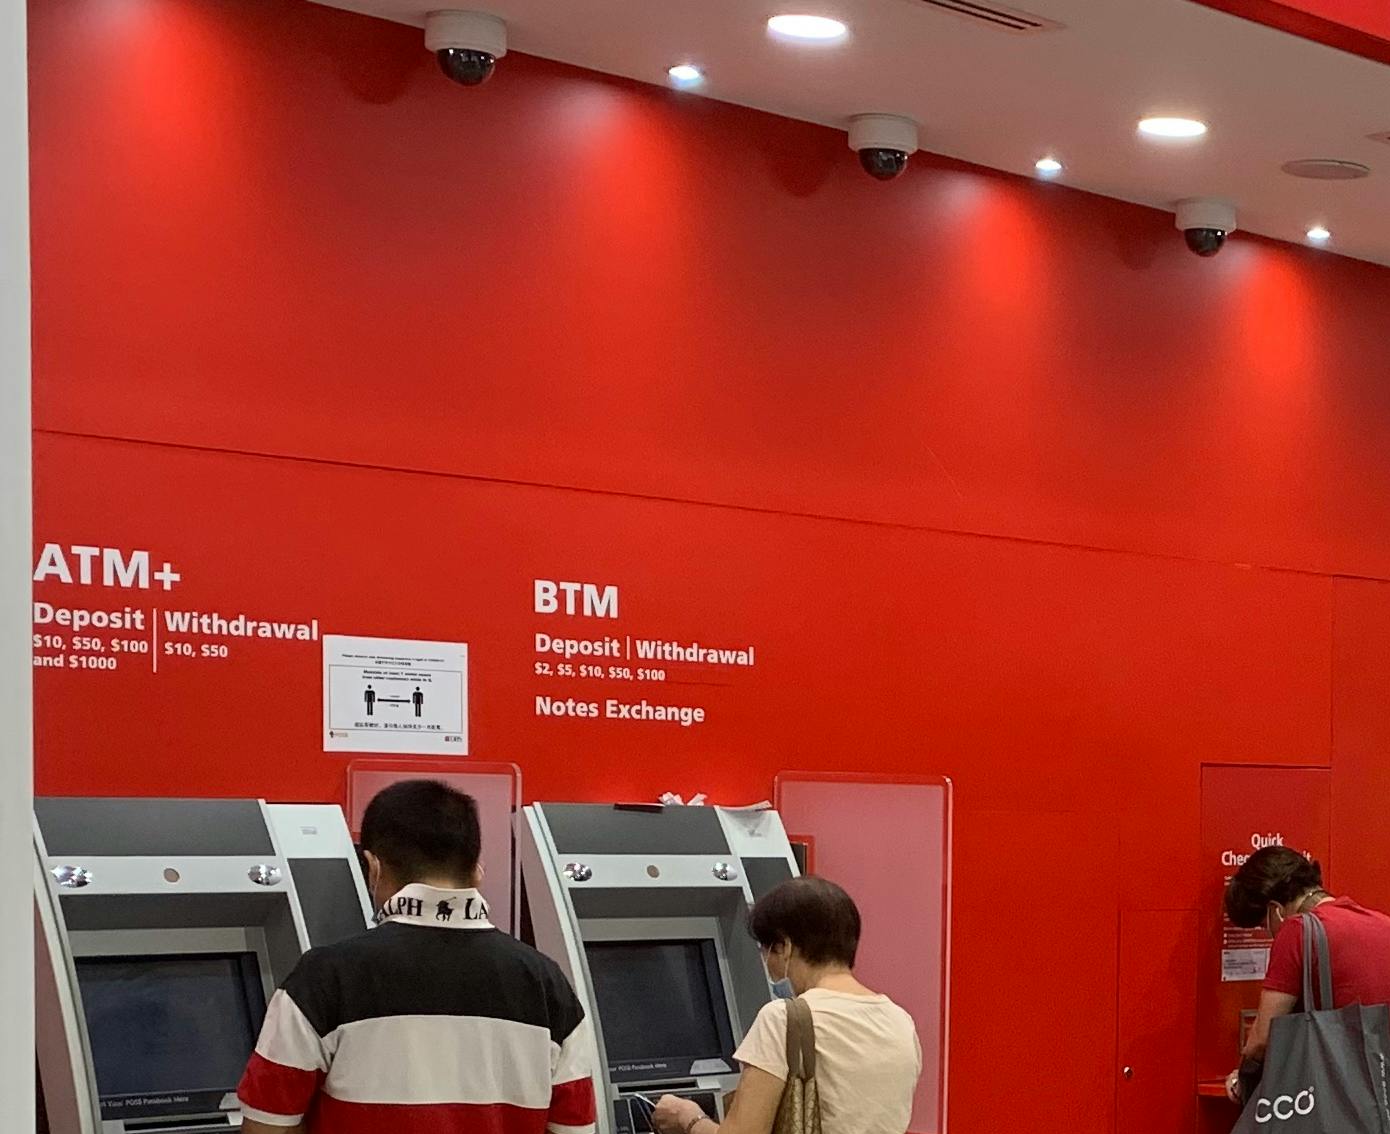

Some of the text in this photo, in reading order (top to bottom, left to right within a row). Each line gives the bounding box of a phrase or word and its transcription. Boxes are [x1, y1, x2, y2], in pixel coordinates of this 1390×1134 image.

[33, 543, 181, 590] ATM+
[534, 579, 619, 618] BTM
[33, 602, 145, 631] Deposit
[164, 610, 319, 640] Withdrawal
[72, 636, 105, 653] $50,
[111, 638, 148, 654] $100
[164, 641, 228, 658] $10, $50
[535, 633, 620, 658] Deposit
[636, 640, 755, 665] Withdrawal
[33, 654, 117, 670] and $1000
[534, 661, 666, 681] $2, $5, $10, $50, $100
[535, 696, 705, 726] Notes Exchange
[1251, 832, 1284, 850] Quick
